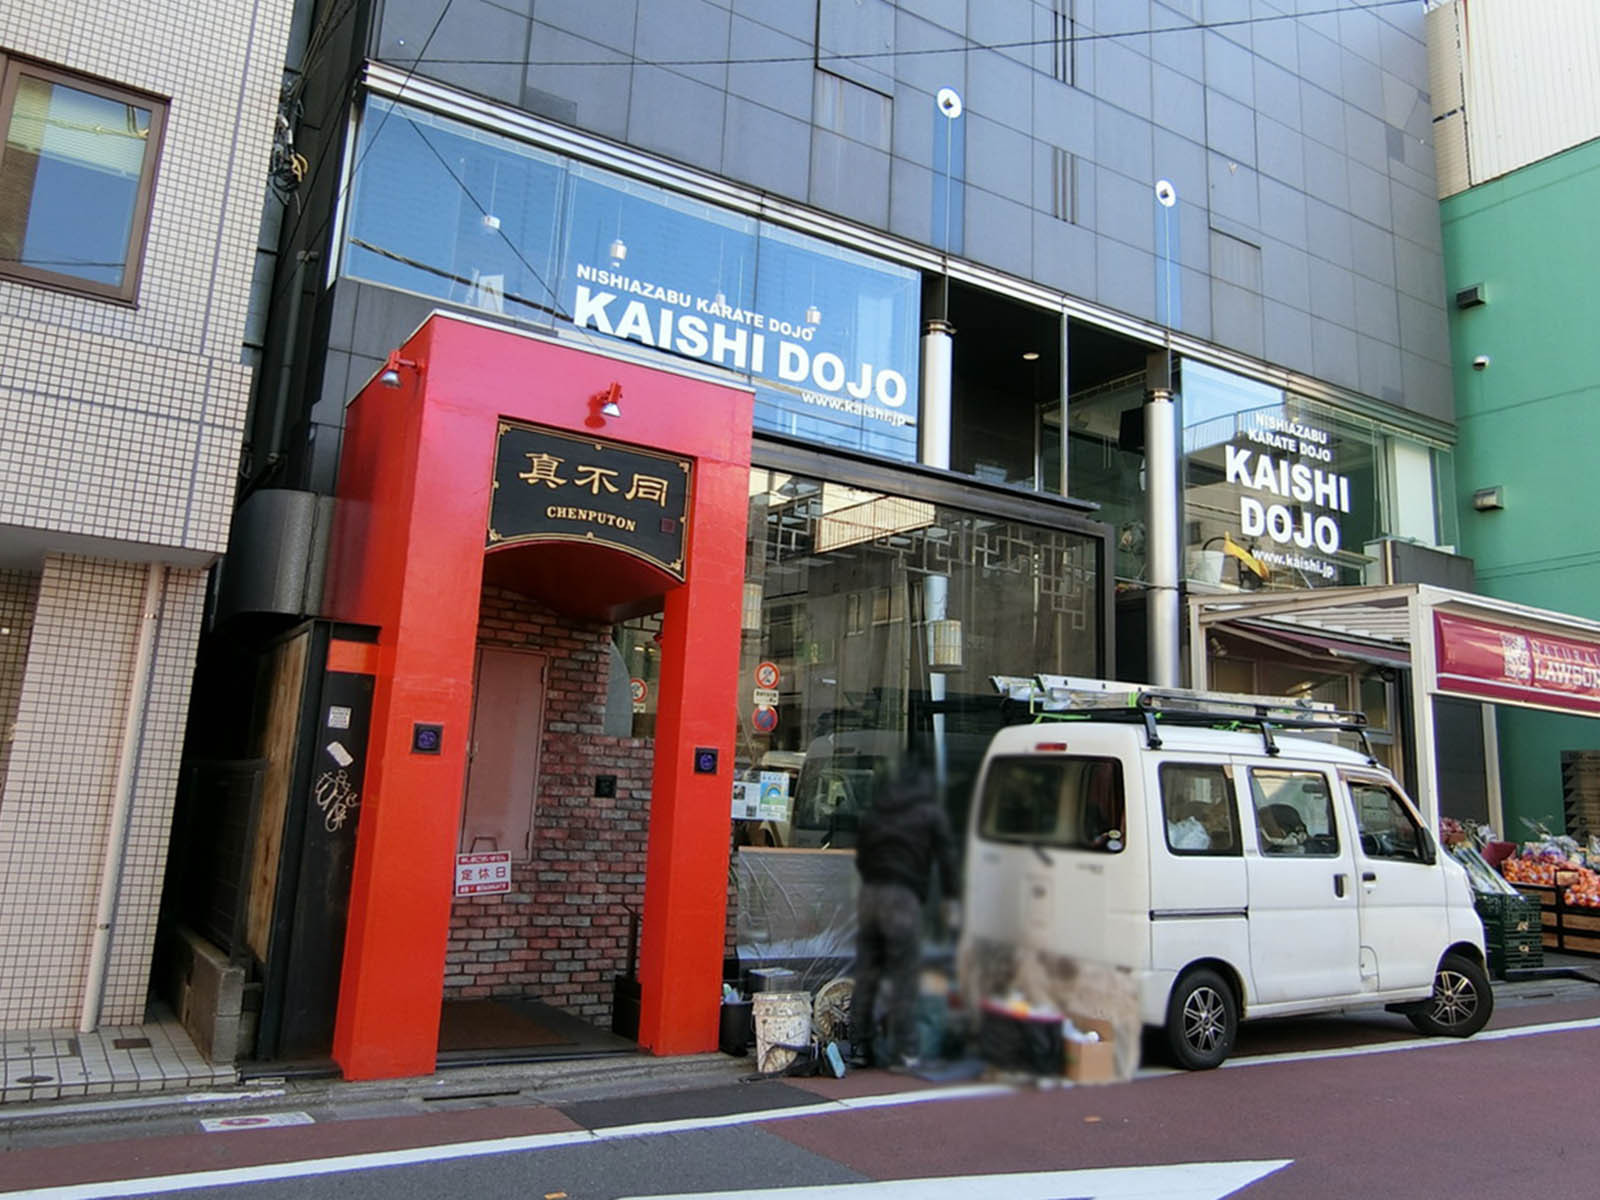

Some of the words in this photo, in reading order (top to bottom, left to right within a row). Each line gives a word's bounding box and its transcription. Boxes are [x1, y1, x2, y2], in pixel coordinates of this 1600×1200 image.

[576, 265, 692, 308] NISHIAZABU
[696, 297, 765, 329] KARATE
[768, 318, 815, 343] DOJO
[573, 286, 764, 372] KAISHI
[778, 341, 907, 408] DOJO
[801, 391, 907, 427] www.kaishi.jp
[1255, 413, 1327, 443] NISHIAZABU
[1248, 428, 1297, 453] KARATE
[1299, 442, 1332, 463] DOJO
[519, 453, 669, 507] 真不同
[1225, 445, 1350, 513] KAISHI
[547, 506, 636, 531] CHENPUTON
[1241, 497, 1339, 554] DOJO
[1252, 549, 1334, 578] www.kaishi.jp
